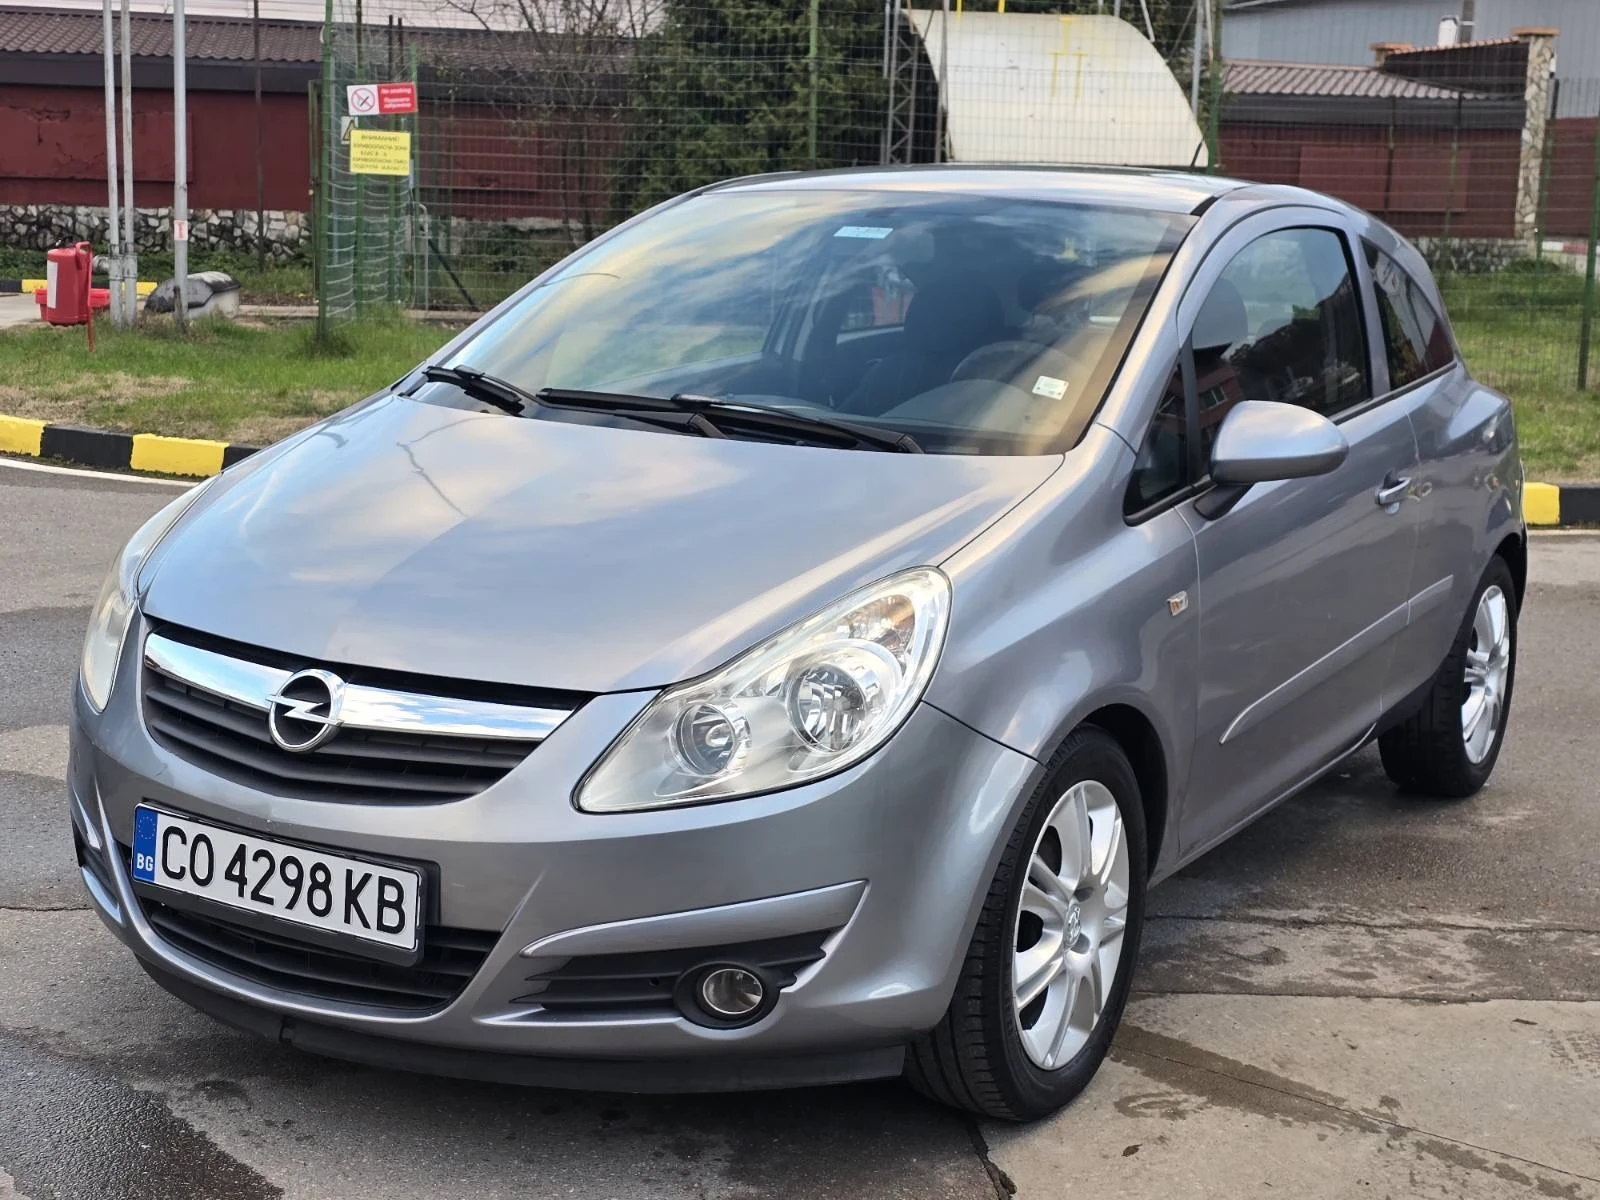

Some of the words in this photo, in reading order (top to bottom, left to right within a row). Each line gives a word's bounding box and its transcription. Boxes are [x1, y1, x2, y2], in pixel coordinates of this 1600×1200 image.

[136, 854, 154, 872] BG
[161, 825, 214, 887] CO
[224, 843, 333, 918] 4298
[343, 868, 406, 935] KB
